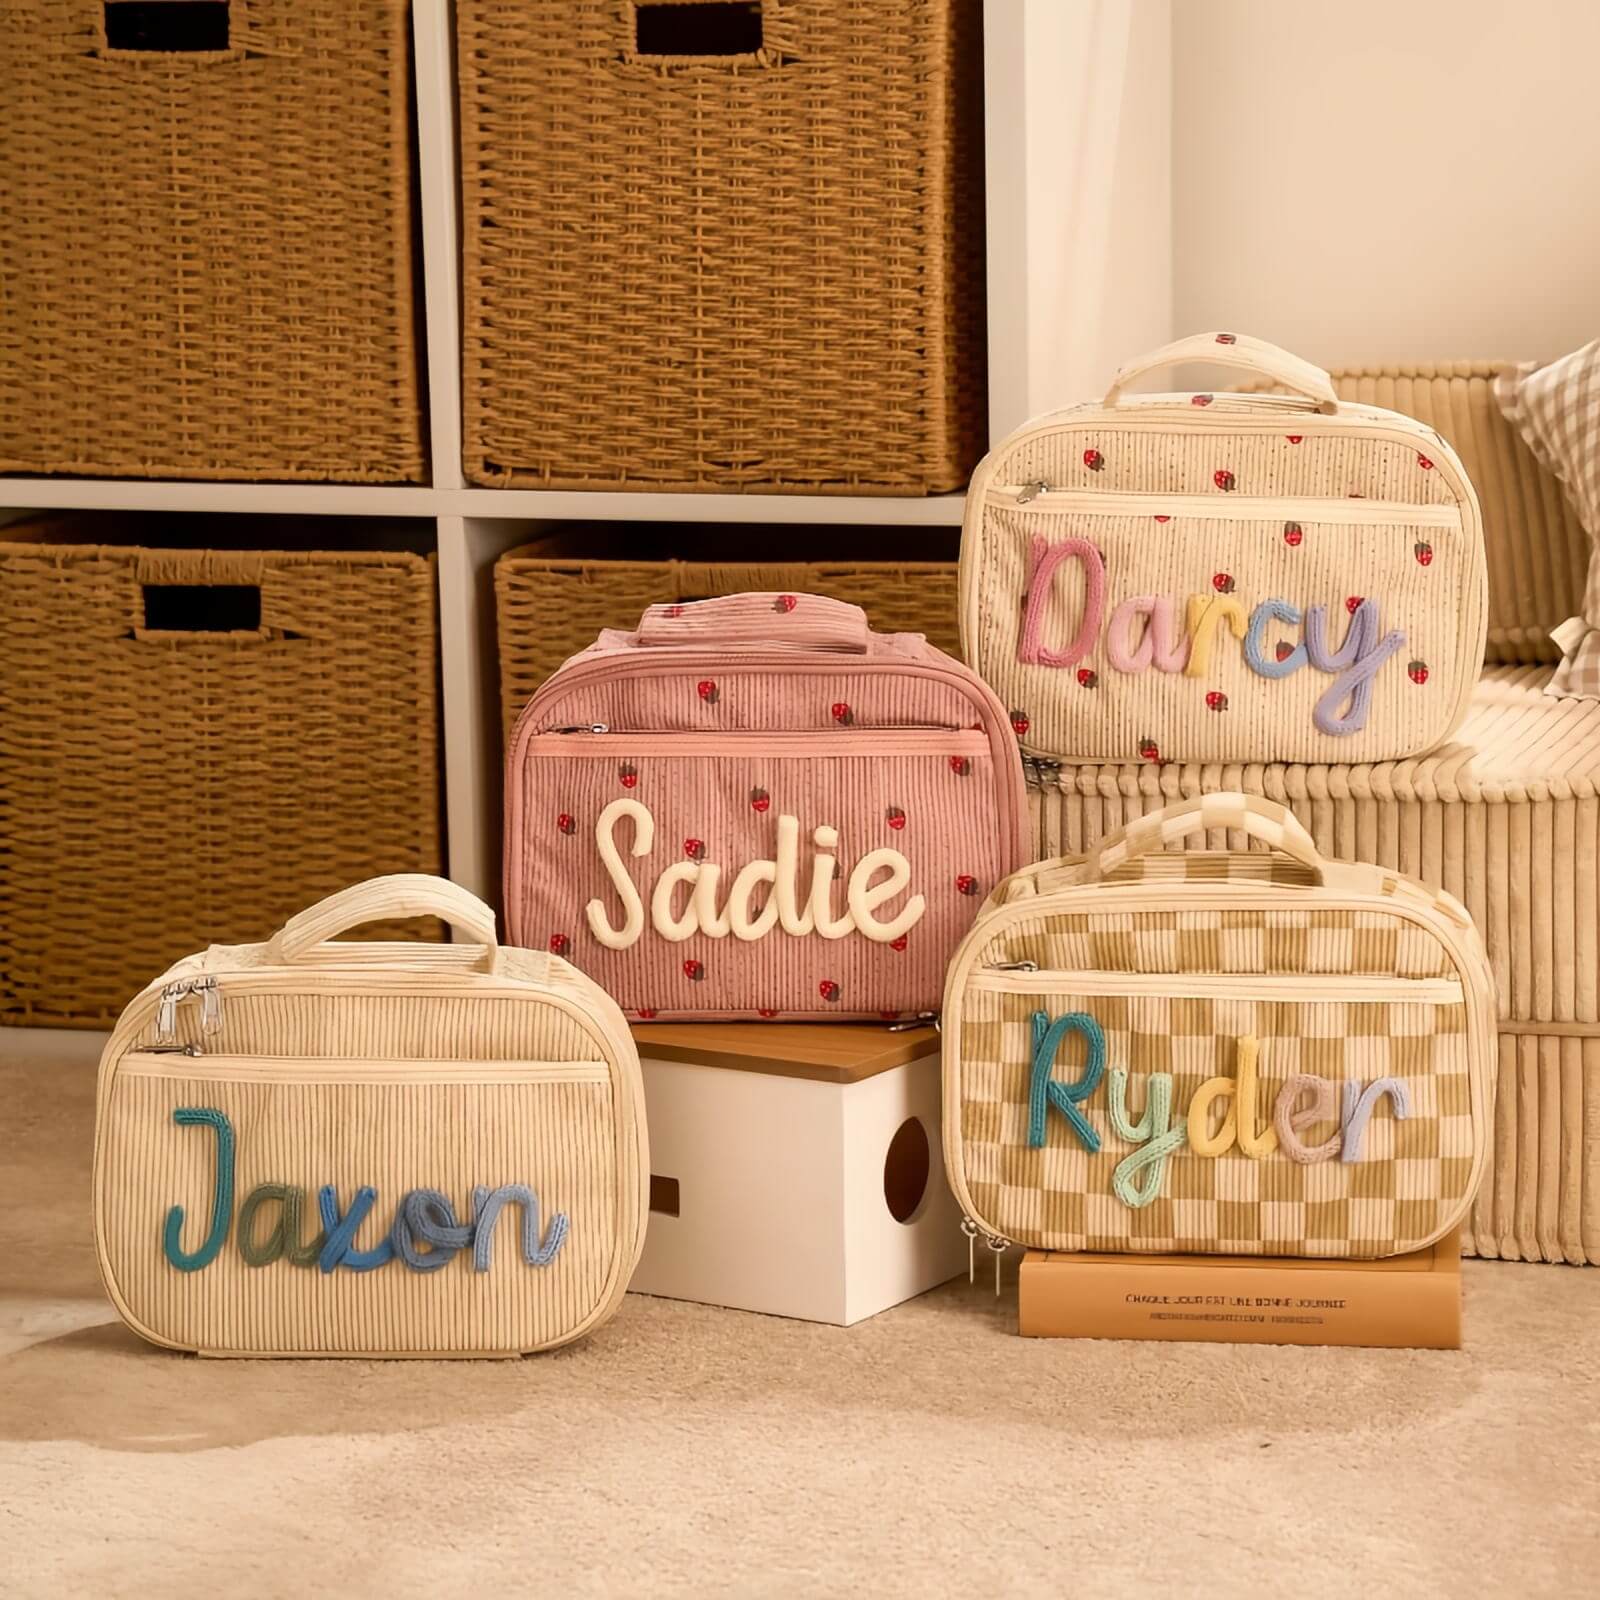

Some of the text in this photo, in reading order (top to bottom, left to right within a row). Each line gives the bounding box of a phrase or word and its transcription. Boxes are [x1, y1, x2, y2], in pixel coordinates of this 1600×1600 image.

[1019, 533, 1406, 736] Darcy
[585, 798, 926, 950] Sadie
[164, 1107, 570, 1273] Jaxon
[1028, 1009, 1410, 1208] Ryder
